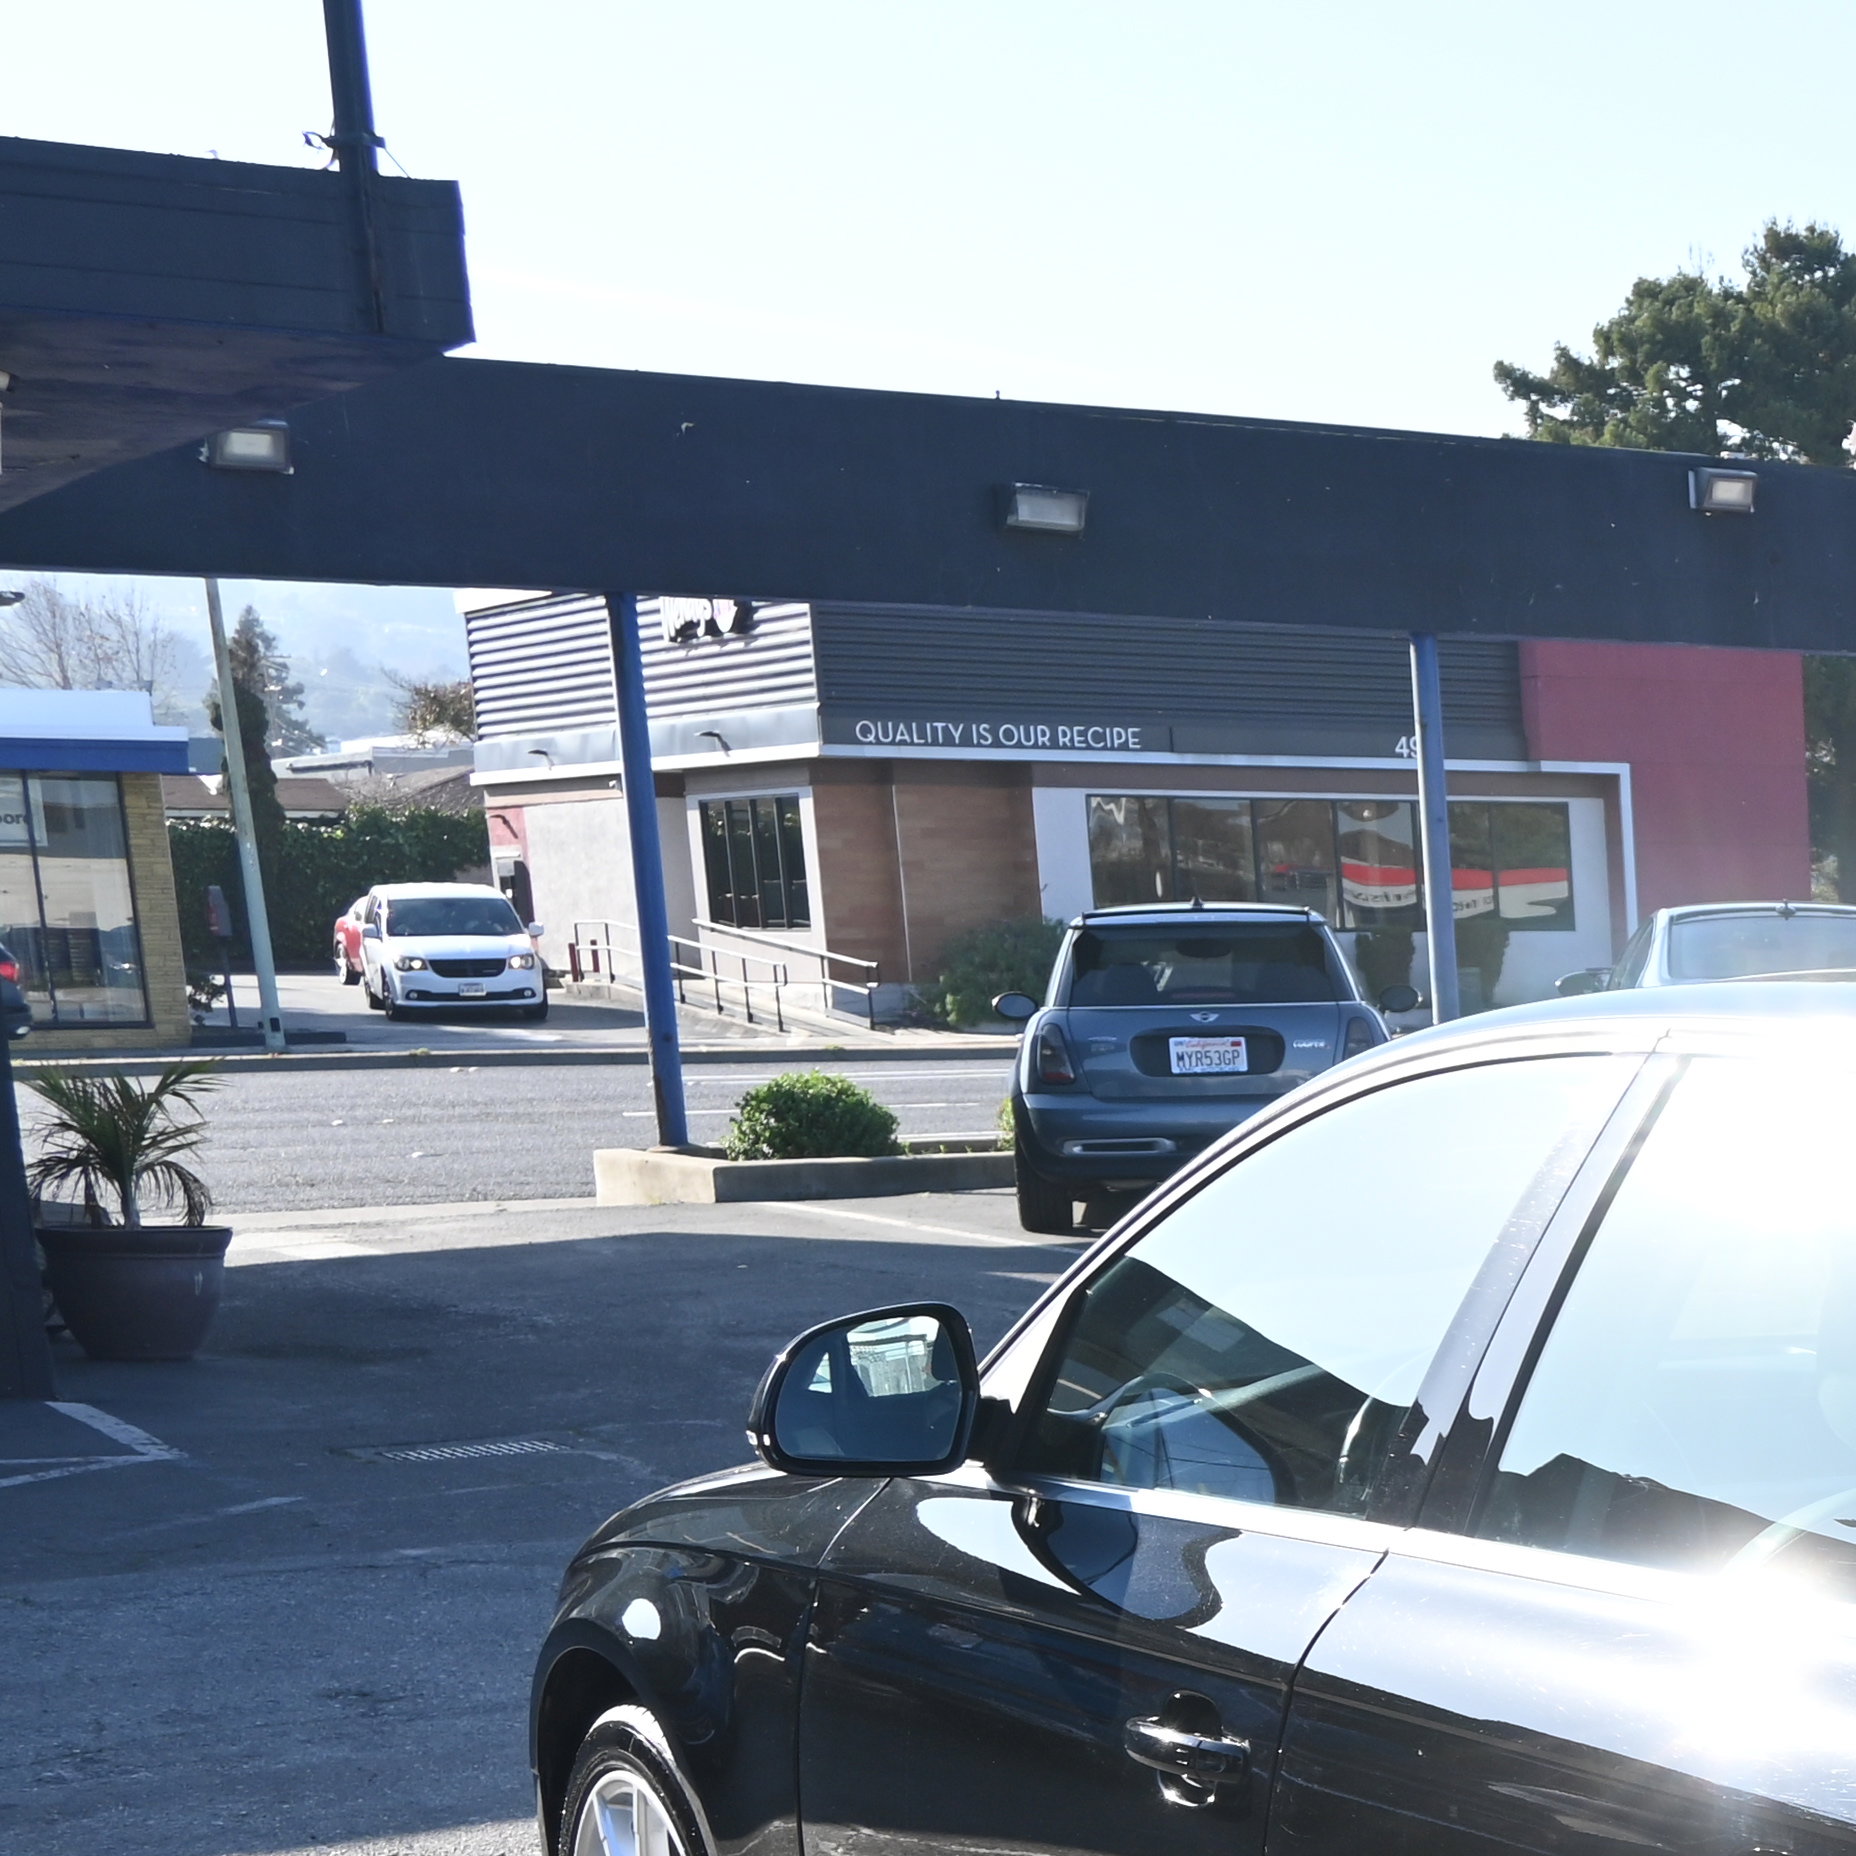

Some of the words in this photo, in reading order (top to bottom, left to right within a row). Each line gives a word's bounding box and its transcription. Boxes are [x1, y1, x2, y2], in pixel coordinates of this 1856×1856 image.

[855, 720, 964, 744] QUALITY
[972, 723, 992, 746] IS
[999, 724, 1051, 746] OUR
[1057, 726, 1142, 749] RECIPE
[1176, 1050, 1240, 1067] MYR53GP
